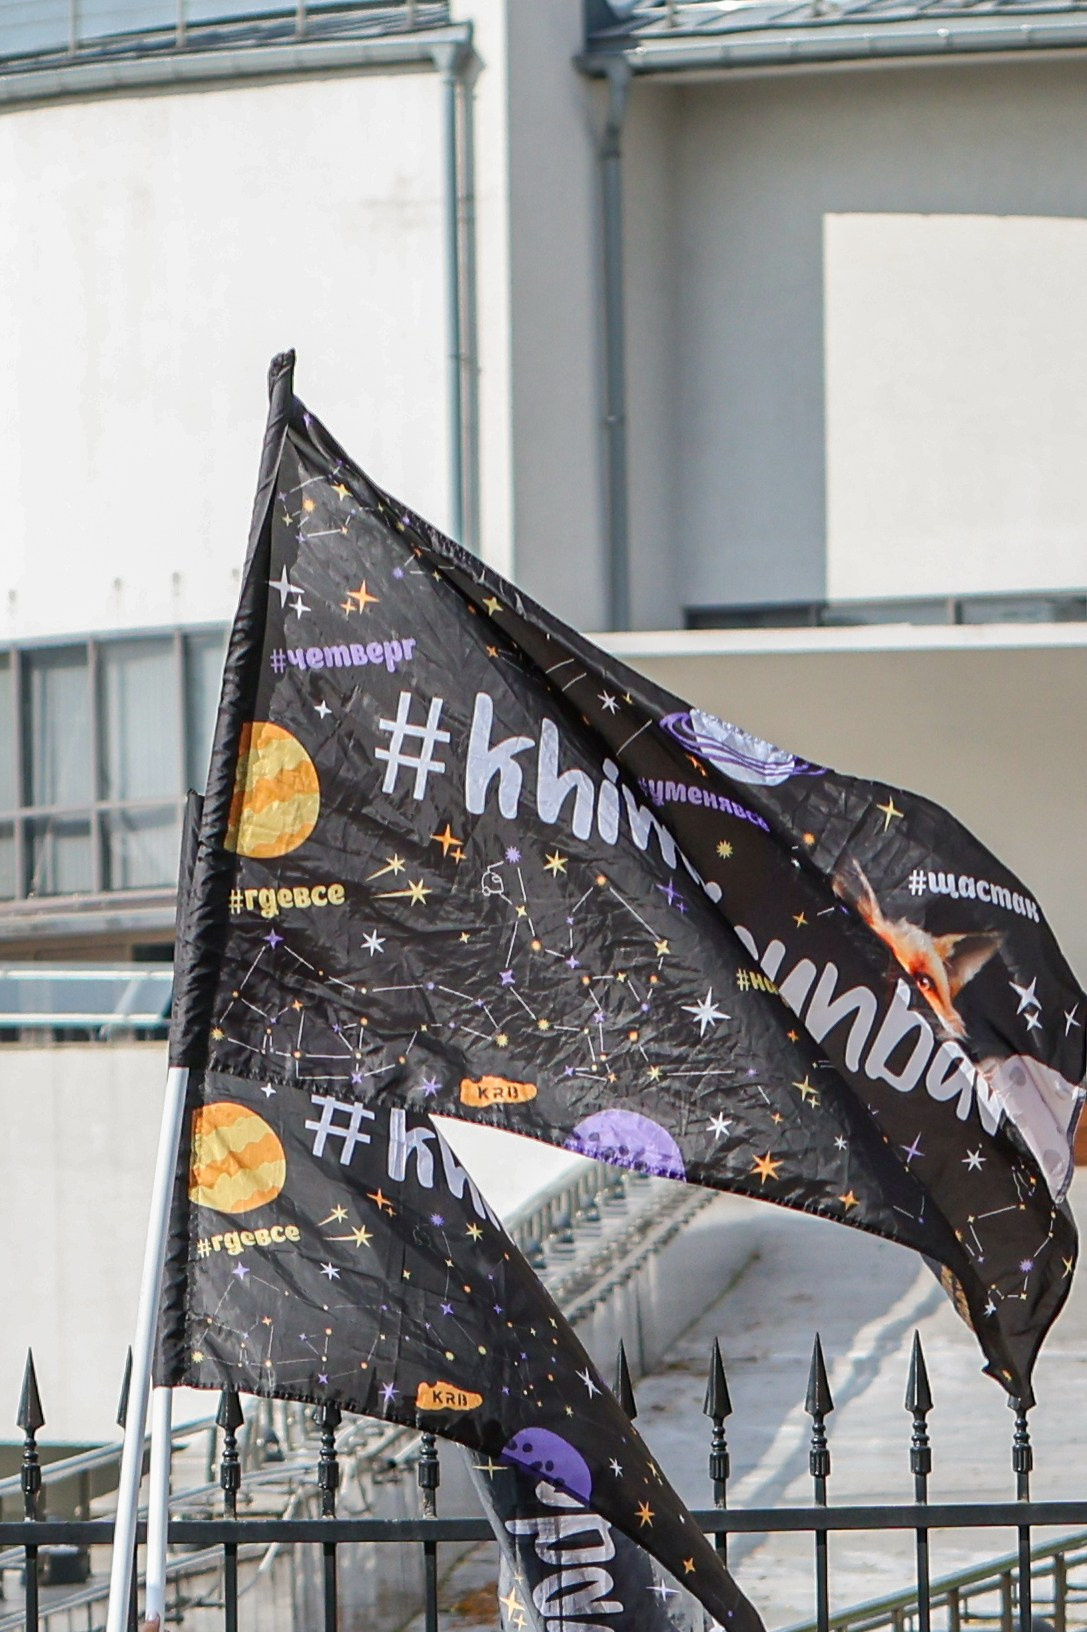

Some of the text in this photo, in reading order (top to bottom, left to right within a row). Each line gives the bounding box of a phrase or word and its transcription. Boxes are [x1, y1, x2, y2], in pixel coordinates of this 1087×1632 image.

[271, 637, 416, 675] #четверг
[229, 883, 345, 917] #гдевсе
[908, 869, 1040, 924] #щастак
[198, 1223, 301, 1258] #гдевсе
